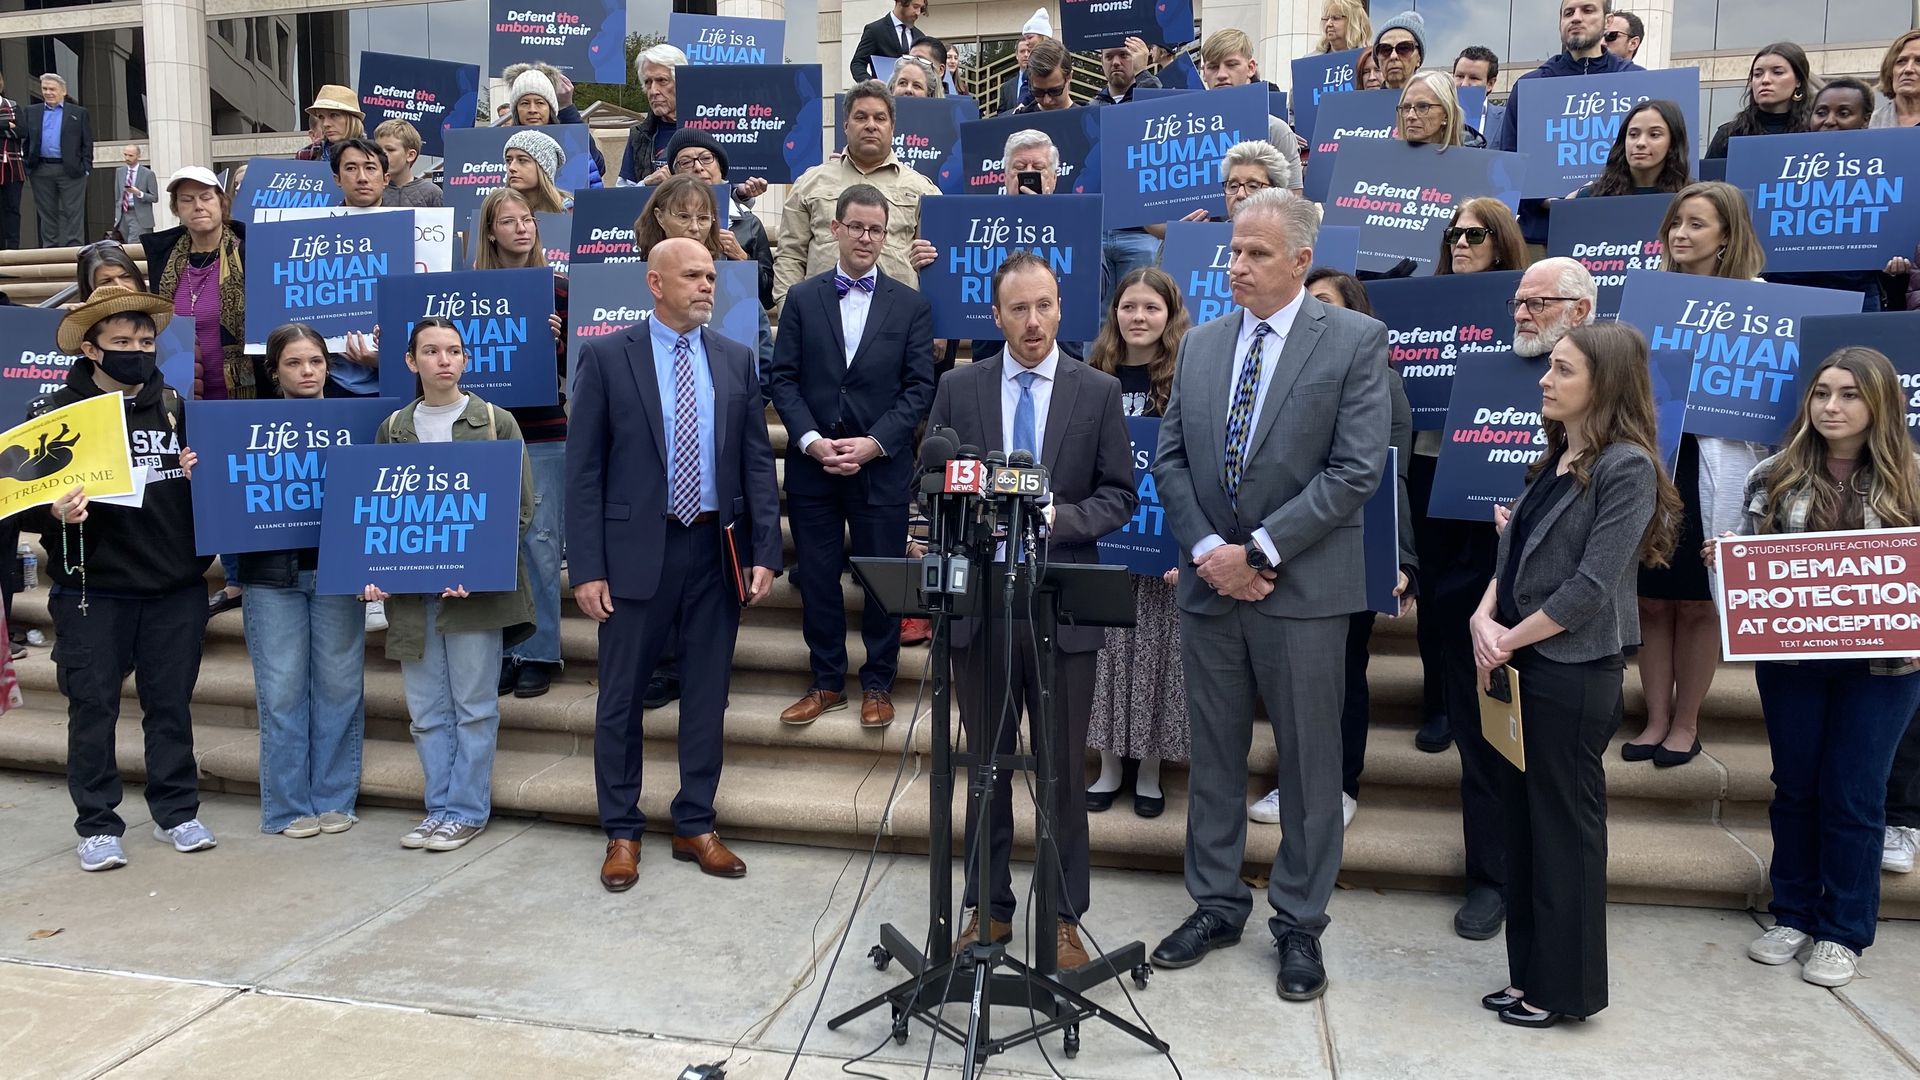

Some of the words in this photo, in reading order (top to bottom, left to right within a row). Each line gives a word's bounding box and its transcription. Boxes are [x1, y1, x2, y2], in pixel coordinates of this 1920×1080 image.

[1090, 0, 1133, 13] moms!
[507, 10, 556, 23] Defend
[556, 13, 579, 24] the
[496, 22, 545, 34] unborn
[546, 24, 557, 35] &
[558, 24, 591, 36] their
[697, 28, 727, 47] Life
[730, 30, 743, 46] is
[746, 35, 756, 46] a
[520, 34, 566, 47] moms!
[686, 44, 766, 64] HUMAN
[1323, 64, 1353, 86] Life
[373, 84, 415, 100] Defend
[415, 90, 436, 102] the
[363, 95, 405, 109] unborn
[405, 100, 416, 111] &
[416, 101, 446, 115] their
[382, 107, 423, 122] moms!
[696, 104, 748, 118] Defend
[748, 104, 773, 117] the
[1562, 92, 1605, 120] Life
[1611, 91, 1631, 112] is
[684, 117, 736, 130] unborn
[737, 118, 749, 131] &
[750, 116, 785, 131] their
[1141, 114, 1182, 145] Life
[1187, 112, 1206, 134] is
[1210, 115, 1225, 131] a
[1546, 115, 1622, 142] HUM
[711, 130, 759, 144] moms!
[905, 134, 929, 147] the
[907, 147, 942, 160] their
[1127, 129, 1241, 170] HUMAN
[1557, 141, 1610, 167] RIG
[1138, 159, 1225, 194] RIGHT
[1778, 152, 1830, 185] Life
[1836, 152, 1860, 177] is
[1866, 158, 1884, 175] a
[267, 172, 296, 193] Life
[298, 173, 313, 190] is
[313, 179, 324, 191] a
[450, 173, 501, 186] unborn
[970, 172, 1006, 186] unbo
[251, 189, 331, 208] HUMAN
[1143, 199, 1169, 207] ALLIANCE
[1169, 195, 1200, 204] DEFENDING
[1201, 192, 1225, 201] FREEDOM
[1353, 181, 1421, 200] Defend
[1421, 188, 1452, 204] the
[1757, 176, 1904, 209] HUMAN
[1335, 194, 1401, 213] unborn
[1402, 201, 1418, 216] &
[1420, 201, 1457, 219] thei
[1366, 212, 1429, 231] moms!
[1769, 206, 1889, 236] RIGHT
[966, 216, 1009, 250] Life
[1016, 218, 1036, 244] is
[1041, 225, 1057, 244] a
[289, 234, 330, 262] Life
[335, 233, 354, 254] is
[358, 237, 373, 252] a
[577, 240, 631, 254] unborn
[1374, 251, 1406, 260] DEFENDING
[1572, 240, 1642, 257] Defend
[1644, 240, 1664, 255] th
[273, 253, 389, 285] HUMAN
[604, 256, 640, 264] mom
[1581, 257, 1624, 271] born
[1626, 257, 1642, 270] &
[284, 278, 378, 309] RIGHT
[422, 292, 465, 319] Life
[470, 292, 491, 316] is
[496, 298, 510, 315] a
[316, 312, 347, 320] DEFENDING
[1676, 299, 1736, 334] Life
[1740, 305, 1768, 335] is
[1775, 318, 1794, 338] a
[1388, 325, 1457, 344] Defend
[1459, 324, 1494, 342] the
[1390, 346, 1439, 362] born
[1440, 344, 1457, 360] &
[1651, 326, 1799, 371] HUMAN
[21, 351, 83, 366] Defen
[1690, 363, 1794, 403] IGHT
[1698, 404, 1740, 416] DEFENDING
[1742, 411, 1776, 421] FREEDOM
[131, 430, 181, 454] SKA
[246, 421, 298, 456] Life
[305, 421, 329, 448] is
[336, 428, 353, 446] a
[1453, 425, 1530, 444] unborn
[1488, 448, 1544, 464] mom
[227, 451, 327, 483] HUM
[949, 461, 975, 484] 13
[13, 479, 59, 500] TREAD
[63, 473, 86, 485] ON
[90, 470, 114, 482] ME
[373, 464, 421, 499] Life
[426, 465, 449, 491] is
[454, 472, 471, 491] a
[997, 475, 1016, 485] abc
[1020, 474, 1039, 491] 15
[353, 492, 487, 524] HUMAN
[364, 523, 474, 555] RIGHT
[1096, 542, 1131, 550] DEFENDING
[1132, 546, 1160, 554] FREEDOM
[1748, 538, 1917, 555] STUDENTSFORLIFEACTION.ORG
[1747, 562, 1756, 581] I
[1768, 555, 1906, 580] DEMAND
[1737, 618, 1768, 635] AT
[1780, 640, 1801, 648] TEXT
[1803, 639, 1838, 647] ACTION
[1855, 638, 1884, 646] 53445
